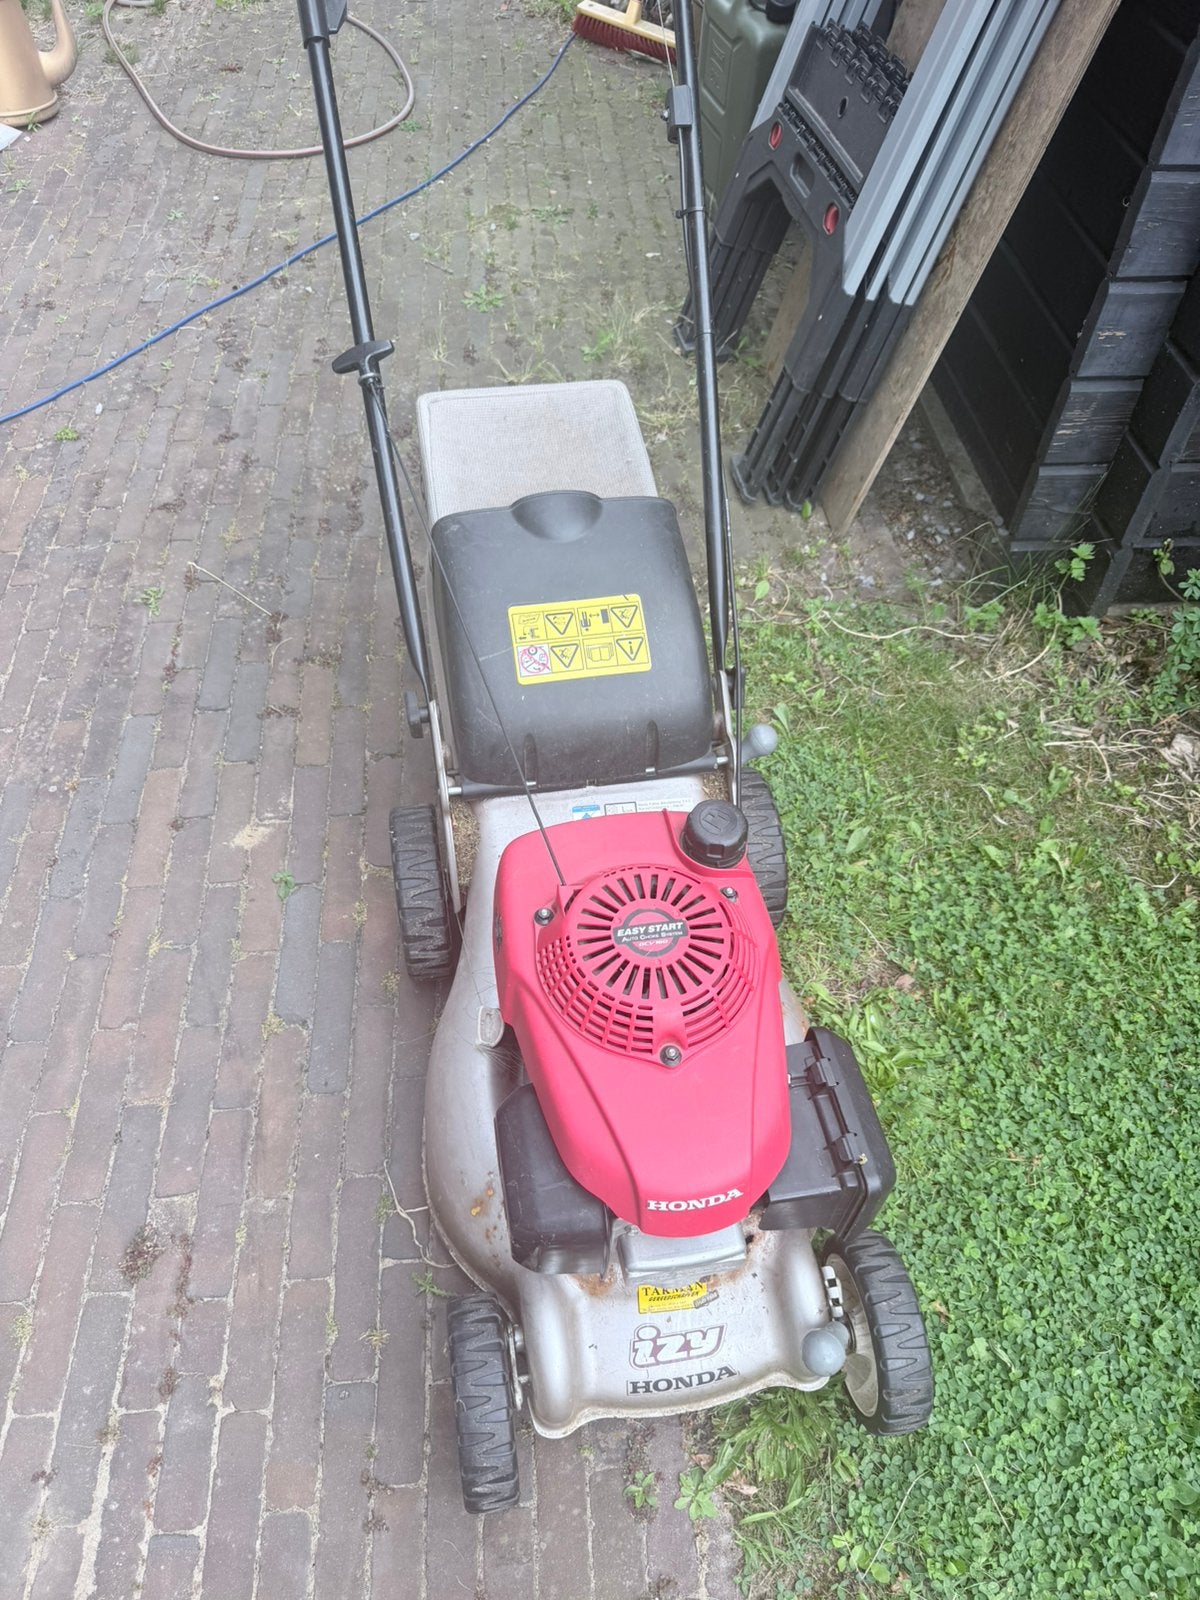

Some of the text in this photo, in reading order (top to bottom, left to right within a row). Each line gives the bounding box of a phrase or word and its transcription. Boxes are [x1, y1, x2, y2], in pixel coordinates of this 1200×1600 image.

[617, 922, 683, 937] EASY START
[647, 1188, 744, 1212] HONDA
[633, 1325, 724, 1368] izy
[630, 1365, 737, 1394] HONDA
